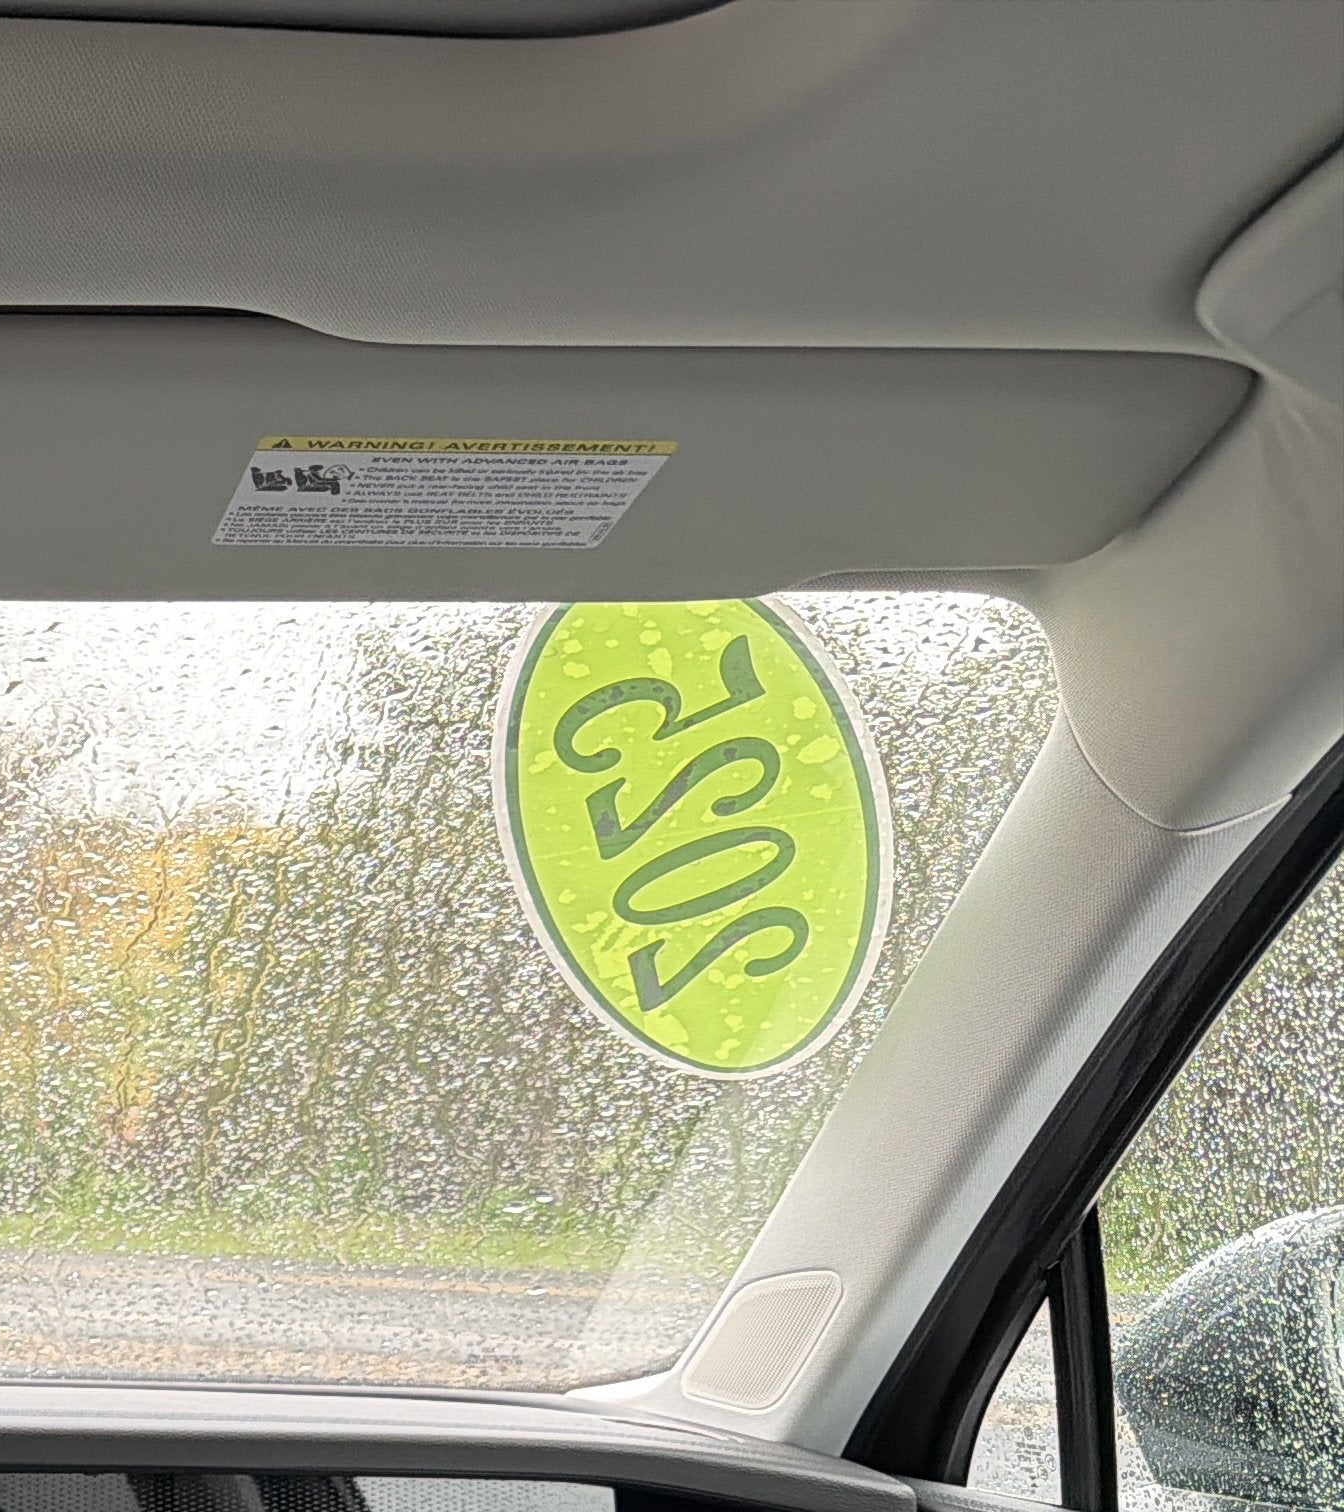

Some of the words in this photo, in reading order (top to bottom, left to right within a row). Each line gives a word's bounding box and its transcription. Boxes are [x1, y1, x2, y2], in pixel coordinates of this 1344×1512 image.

[307, 440, 434, 450] WARNING!
[444, 442, 656, 452] AVERTISSEMENT!
[462, 457, 547, 465] ADVANCED
